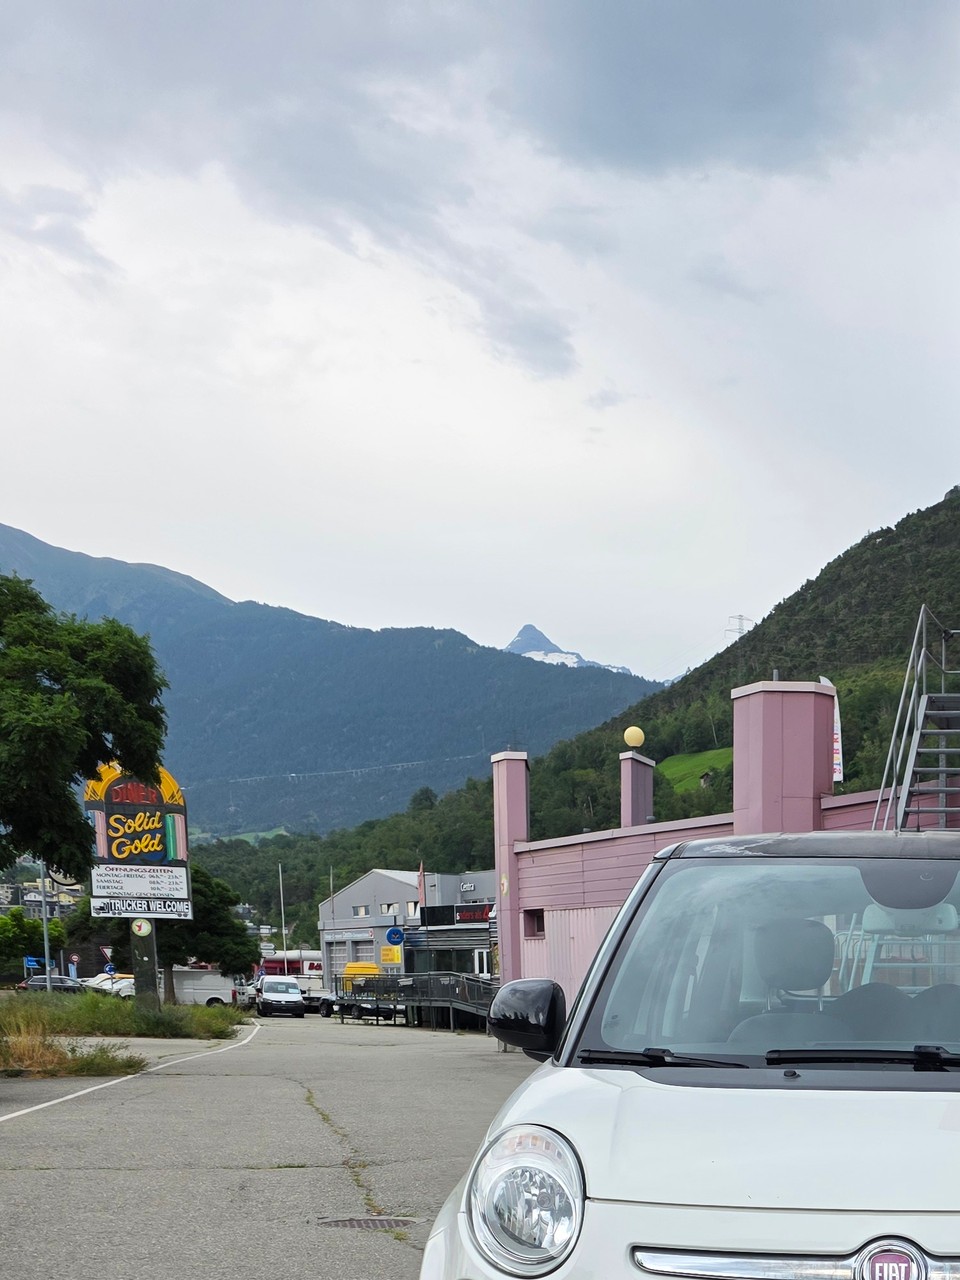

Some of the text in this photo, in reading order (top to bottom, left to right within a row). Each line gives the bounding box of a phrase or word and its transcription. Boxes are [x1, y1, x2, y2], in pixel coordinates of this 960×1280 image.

[111, 782, 157, 803] DINER
[108, 811, 163, 838] Solid
[111, 833, 164, 859] Gold
[105, 865, 174, 874] ÖFFNUNGSZEITEN
[110, 900, 190, 912] TRUCKER WELCOME
